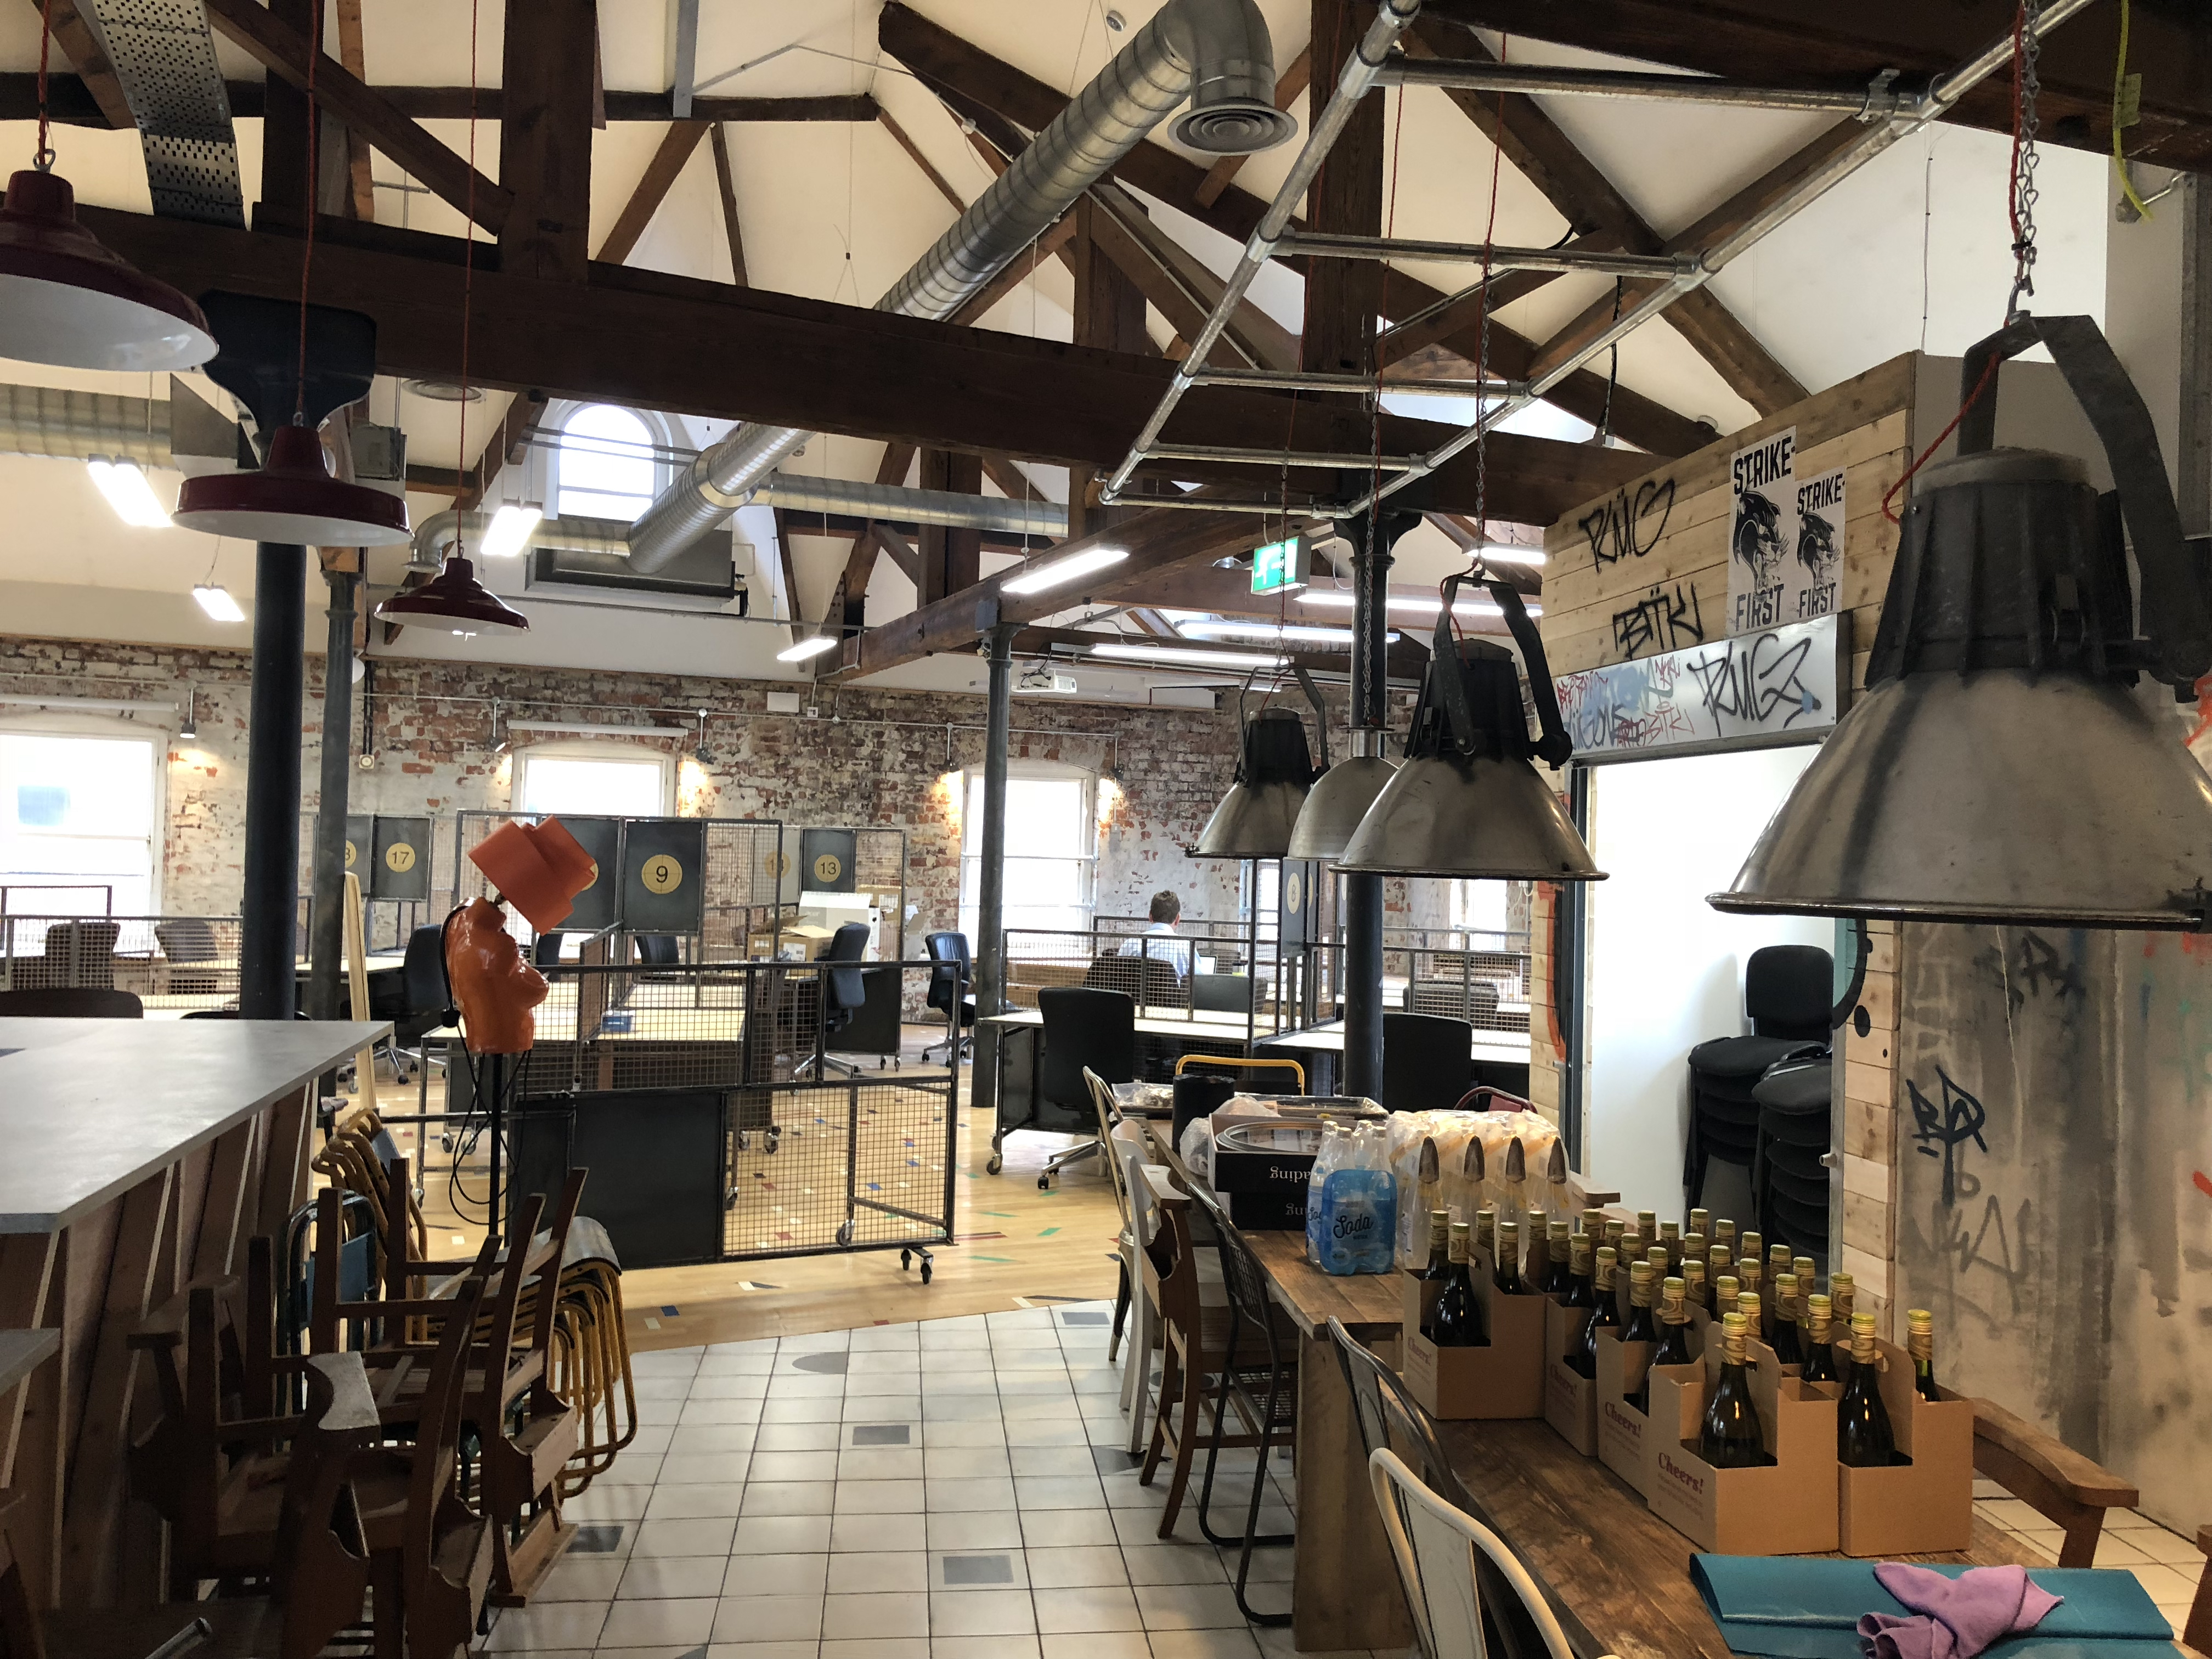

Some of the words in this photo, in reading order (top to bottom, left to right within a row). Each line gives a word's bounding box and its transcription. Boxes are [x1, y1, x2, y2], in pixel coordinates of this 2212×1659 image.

[1735, 583, 1784, 631] FIRST
[1799, 583, 1836, 618] FIRST
[392, 851, 410, 865] 17
[820, 861, 837, 875] 13
[656, 865, 668, 883] 9
[1291, 884, 1296, 902] 8
[1269, 1166, 1311, 1183] ading
[1333, 1213, 1373, 1239] Soda
[1605, 1401, 1640, 1438] Cheers!
[1658, 1452, 1703, 1495] Cheers!
